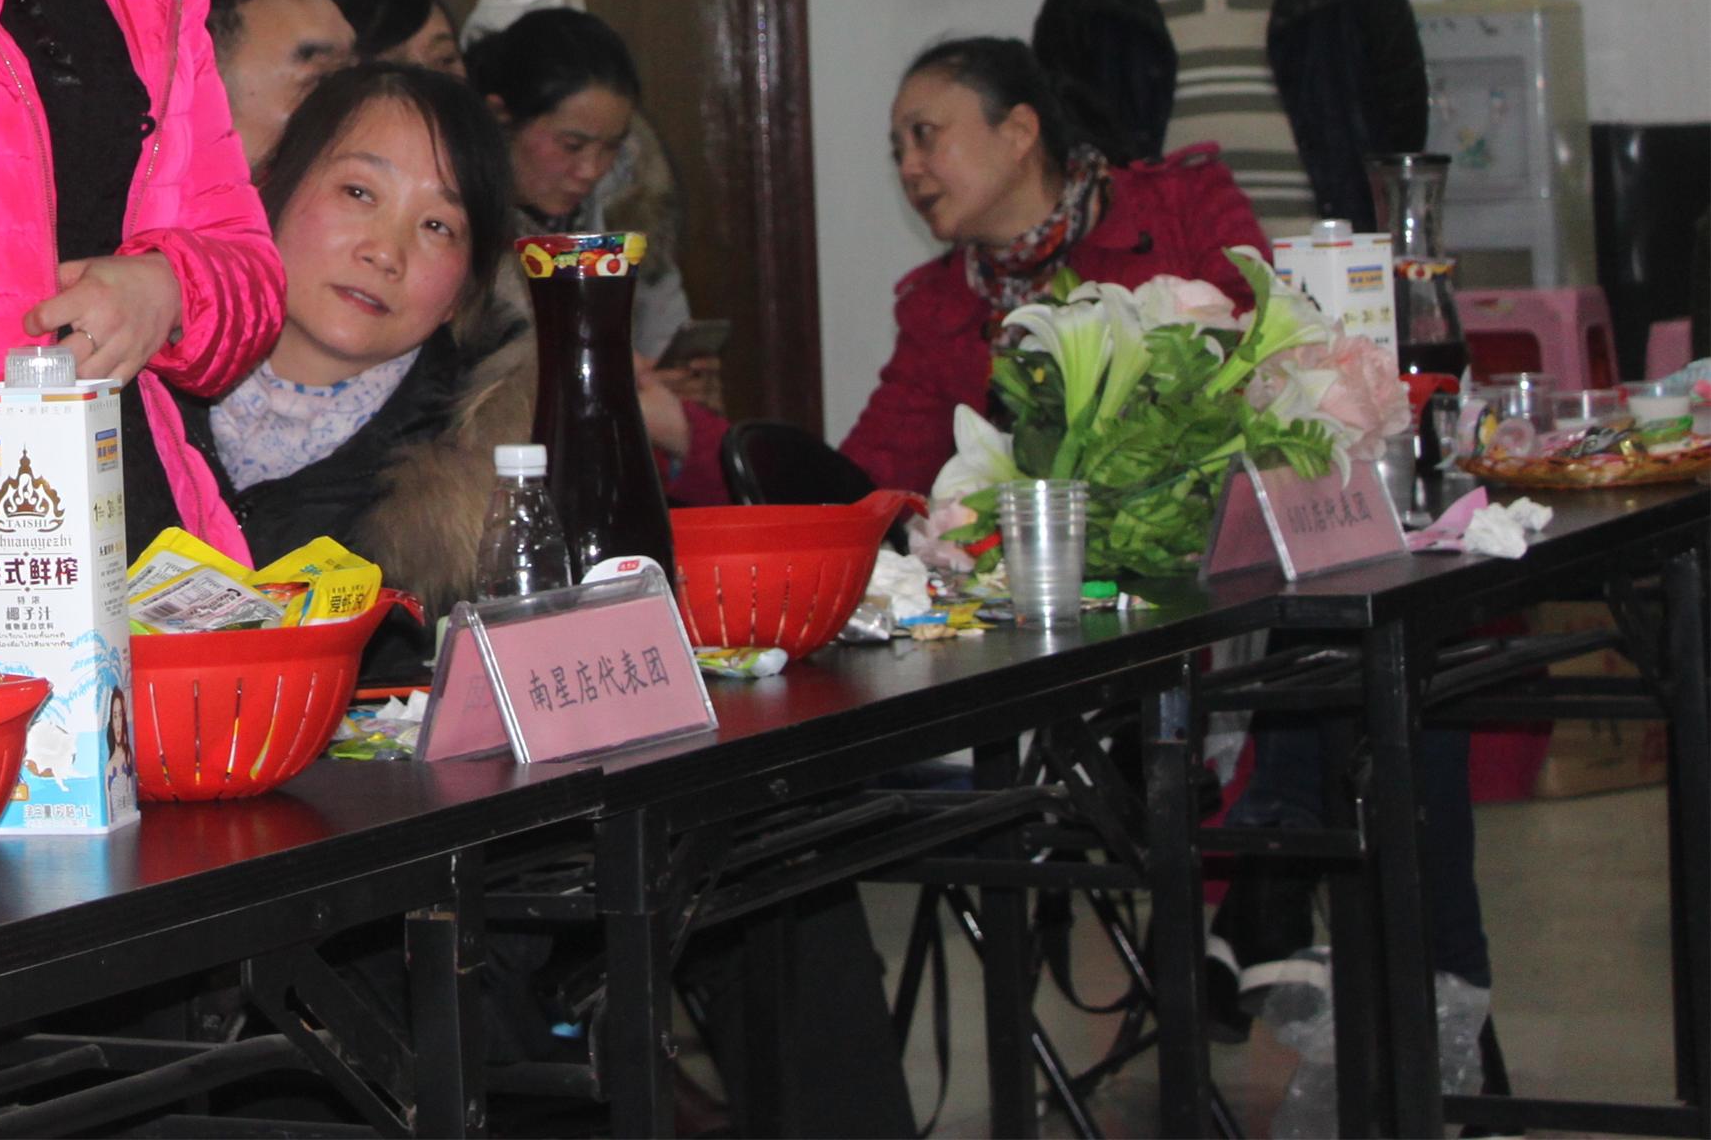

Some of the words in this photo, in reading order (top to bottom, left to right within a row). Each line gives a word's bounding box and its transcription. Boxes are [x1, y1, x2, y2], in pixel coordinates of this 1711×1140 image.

[6, 519, 47, 529] TAISHI
[6, 606, 50, 621] 椰子汁
[528, 646, 670, 712] 南星店代表团
